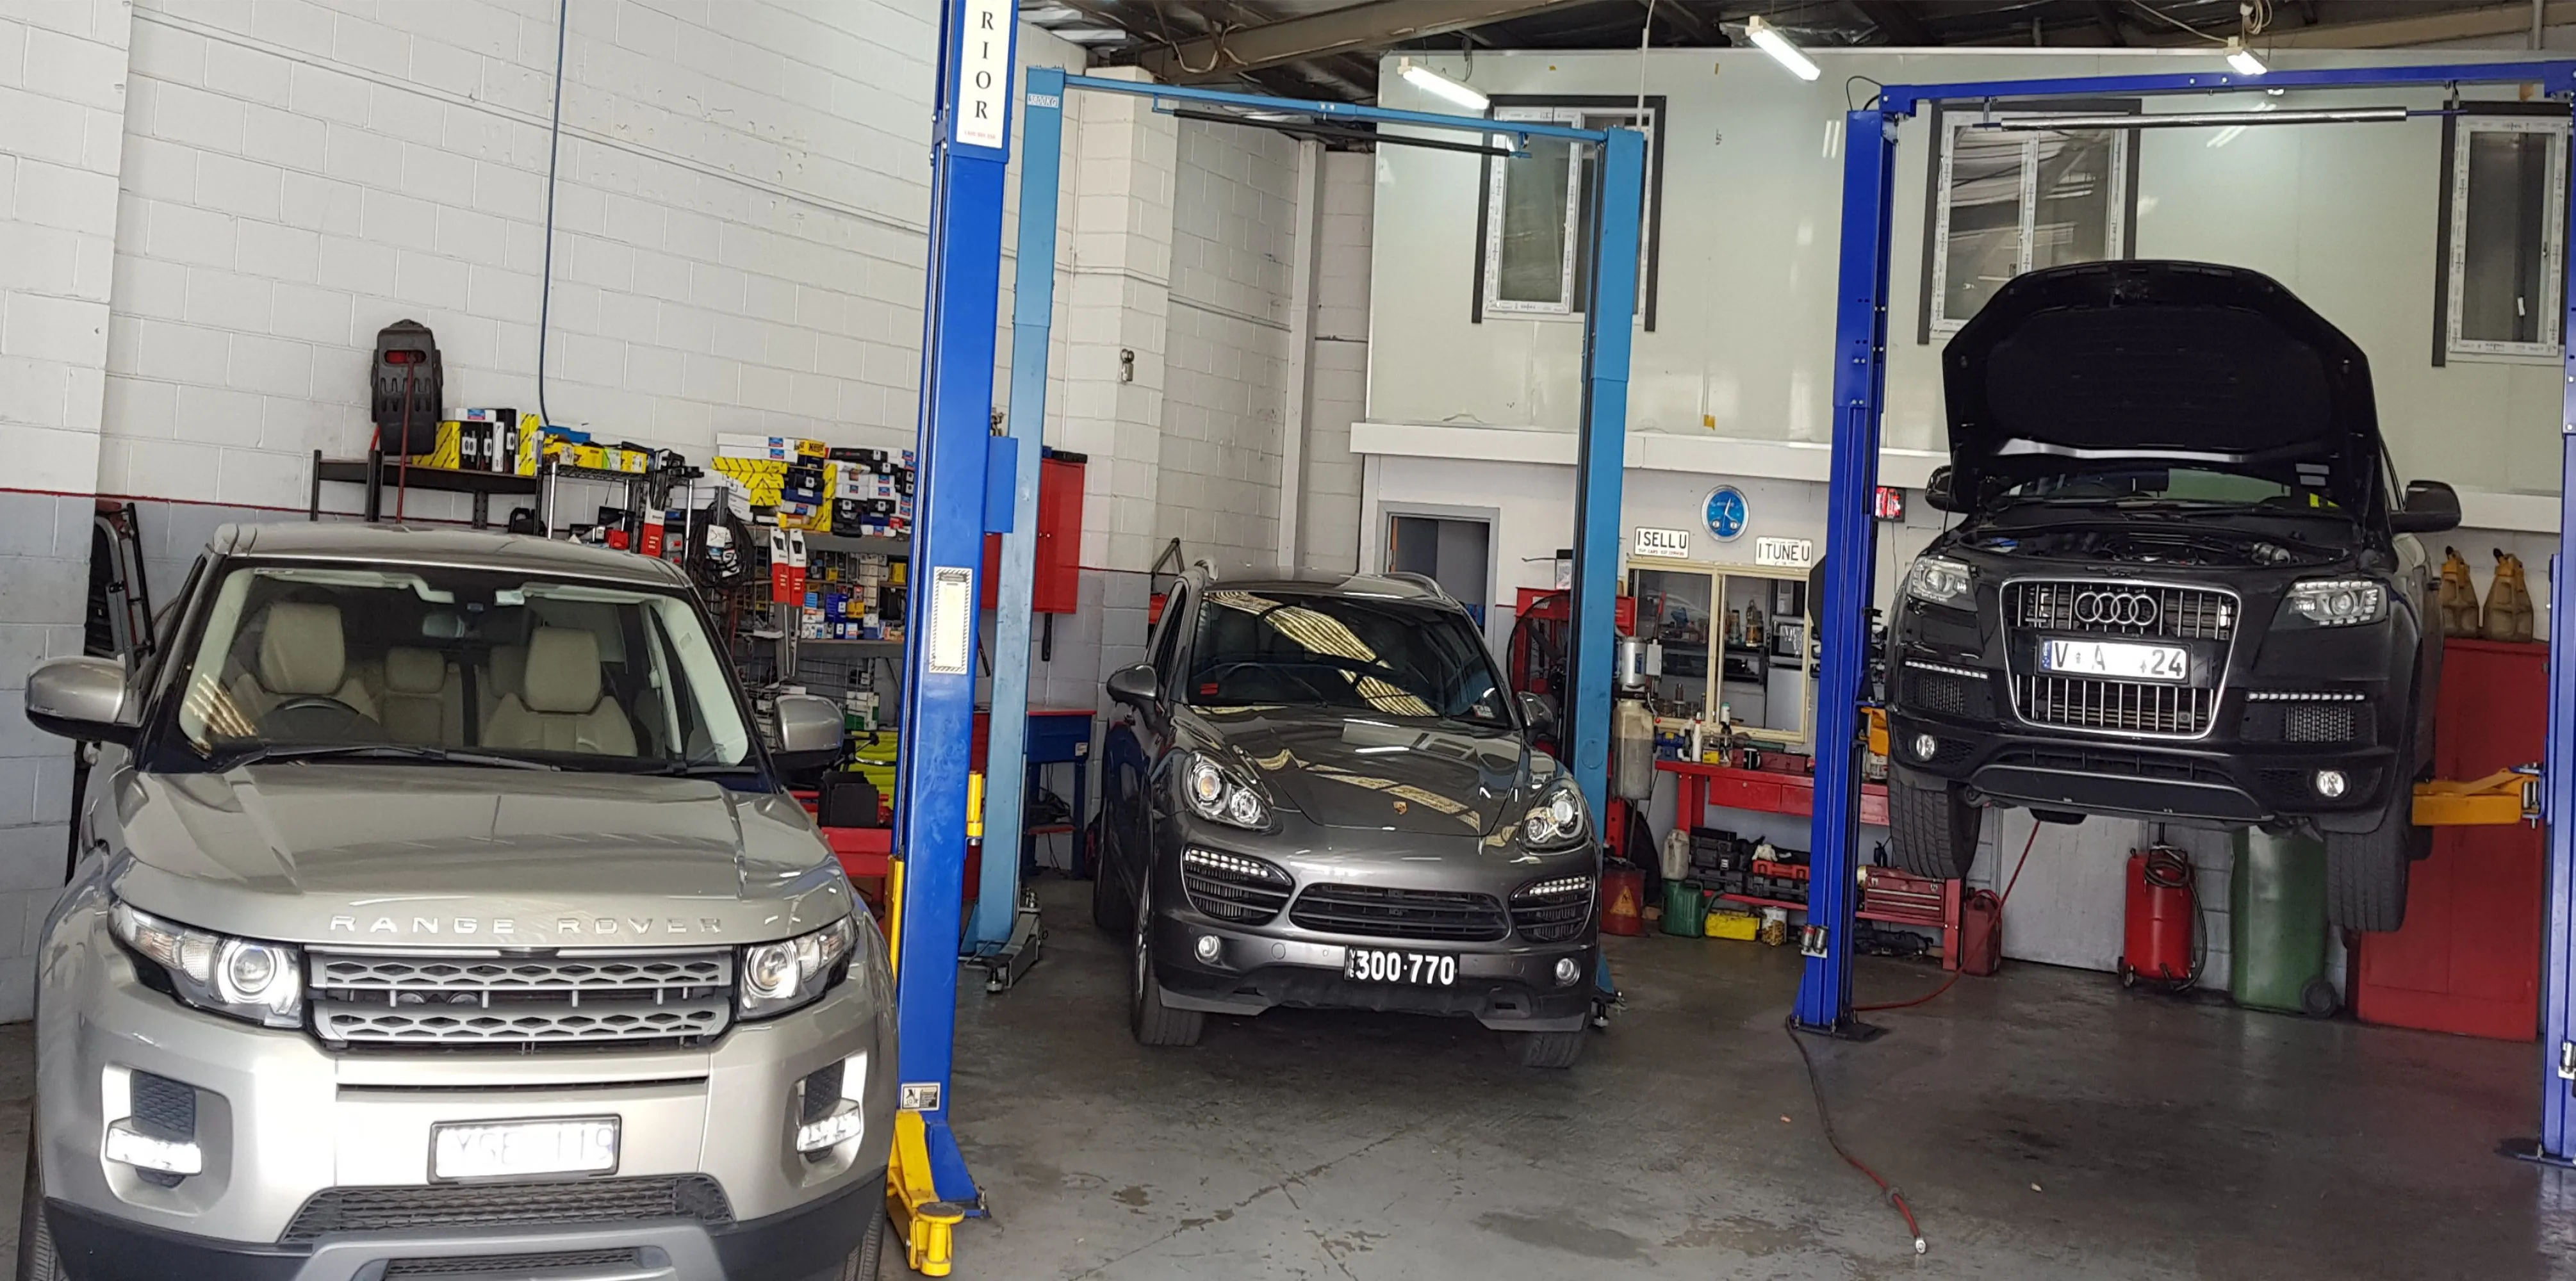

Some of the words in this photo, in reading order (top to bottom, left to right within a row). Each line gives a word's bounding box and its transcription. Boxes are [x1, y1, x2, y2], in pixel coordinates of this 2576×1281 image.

[1637, 530, 1641, 546] I
[1643, 531, 1676, 548] SELL
[1679, 534, 1687, 549] U
[1759, 543, 1762, 559] I
[1766, 543, 1799, 561] TUNE
[1801, 545, 1810, 562] U
[329, 916, 516, 934] RANGE
[557, 917, 722, 934] ROVER
